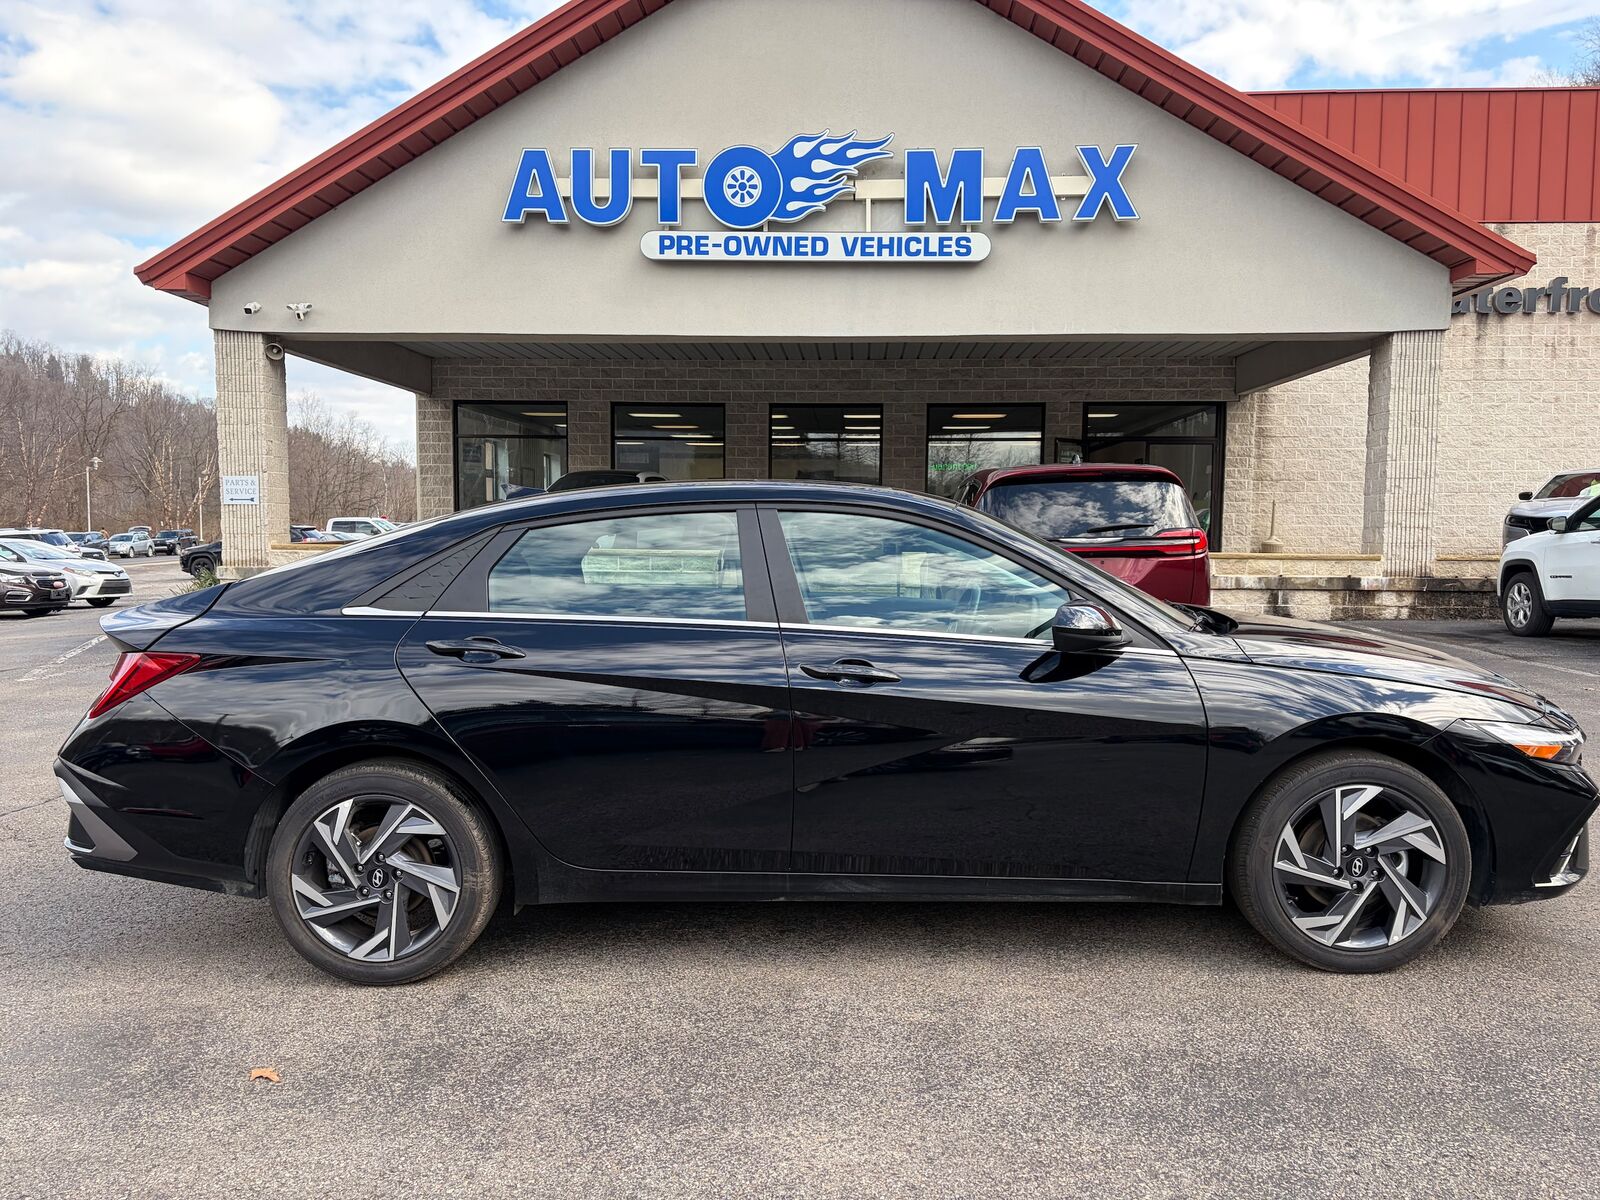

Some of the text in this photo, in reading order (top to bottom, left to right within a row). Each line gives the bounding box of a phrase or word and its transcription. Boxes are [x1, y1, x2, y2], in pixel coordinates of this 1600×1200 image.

[501, 144, 1140, 228] AUTO MAX
[658, 235, 972, 257] PRE-OWNED VEHICLES
